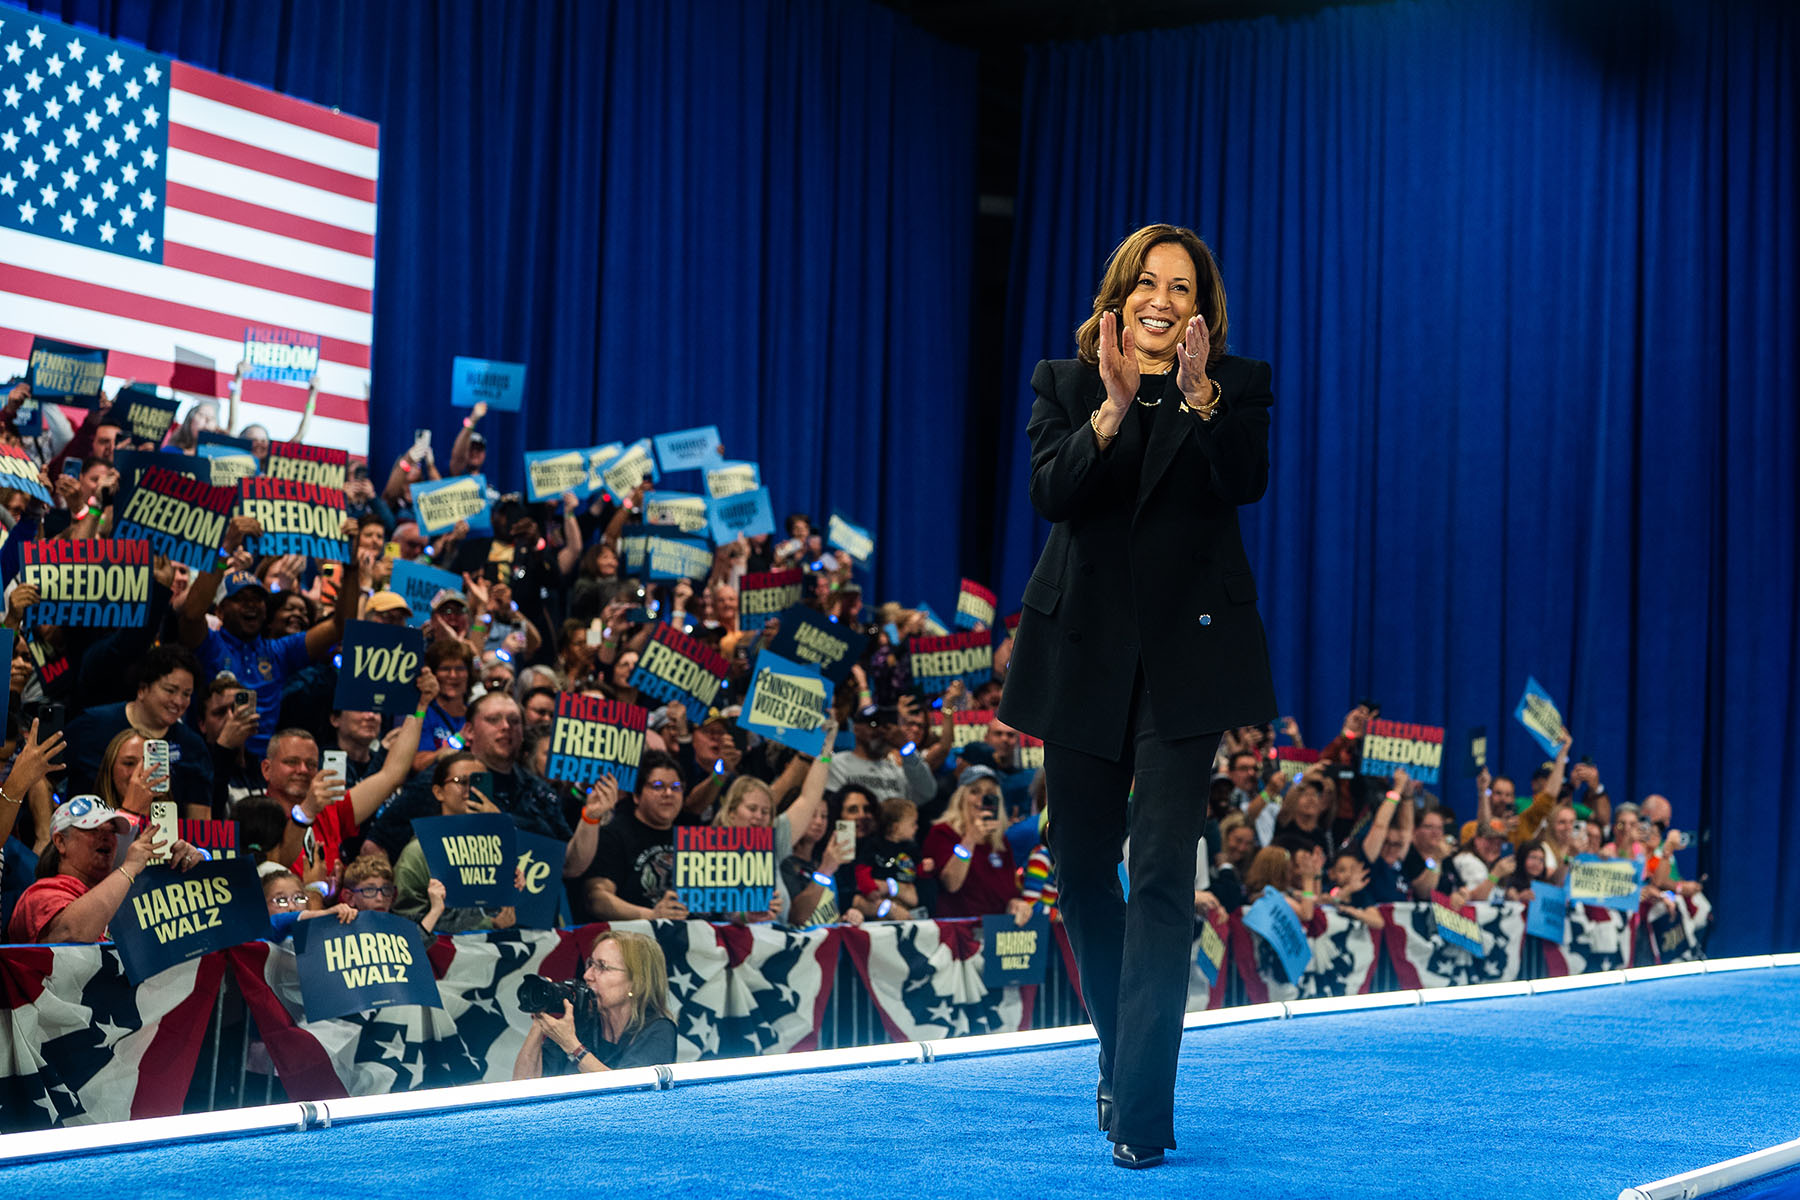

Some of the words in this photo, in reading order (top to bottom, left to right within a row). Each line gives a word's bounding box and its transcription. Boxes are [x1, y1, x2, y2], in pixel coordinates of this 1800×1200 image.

[245, 341, 319, 370] FREEDOM
[35, 369, 73, 392] VOTES
[267, 455, 346, 491] FREEDOM
[242, 477, 346, 511] FREEDOM
[123, 487, 226, 549] FREEDOM
[243, 500, 350, 542] FREEDOM
[24, 539, 149, 565] FREEDOM
[25, 564, 149, 602] FREEDOM
[354, 642, 418, 684] vote
[639, 639, 721, 706] FREEDOM
[911, 644, 992, 678] FREEDOM
[559, 691, 648, 732] FREEDOM
[755, 692, 789, 721] VOTES
[787, 704, 821, 733] EARLY
[552, 716, 644, 768] FREEDOM
[1363, 734, 1442, 768] FREEDOM
[442, 835, 502, 866] HARRIS
[677, 826, 773, 850] FREEDOM
[459, 866, 496, 886] WALZ
[676, 851, 774, 888] FREEDOM
[132, 877, 232, 930] HARRIS
[154, 907, 222, 944] WALZ
[996, 930, 1037, 956] HARRIS
[324, 932, 413, 972] HARRIS
[1002, 955, 1030, 971] WALZ
[342, 965, 408, 989] WALZ
